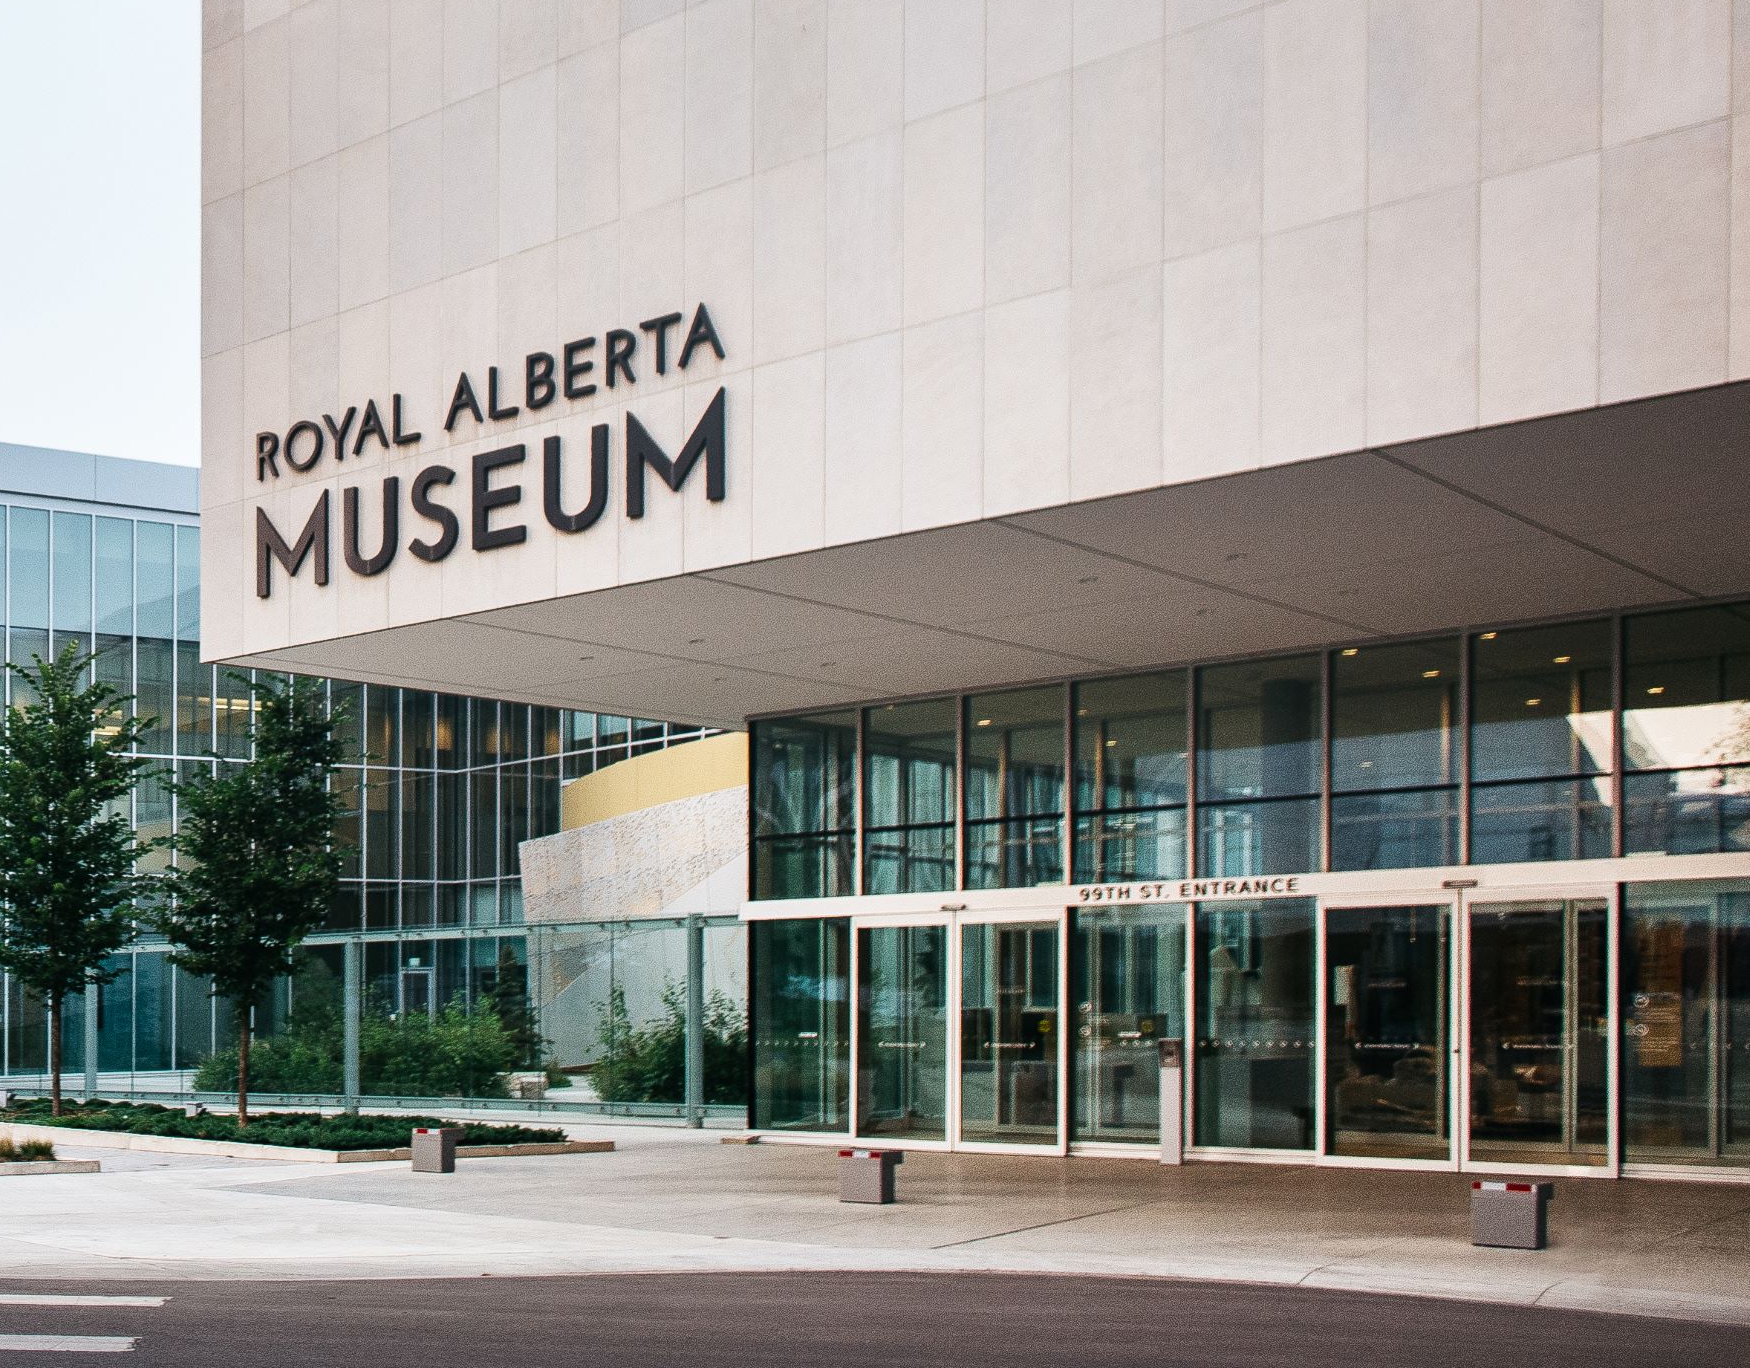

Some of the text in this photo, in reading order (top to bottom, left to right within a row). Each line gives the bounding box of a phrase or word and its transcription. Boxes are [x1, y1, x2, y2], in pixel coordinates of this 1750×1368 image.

[256, 302, 726, 482] ROYAL ALBERTA
[256, 387, 726, 599] MUSEUM
[1079, 877, 1300, 902] 99TH ST. ENTRANCE
